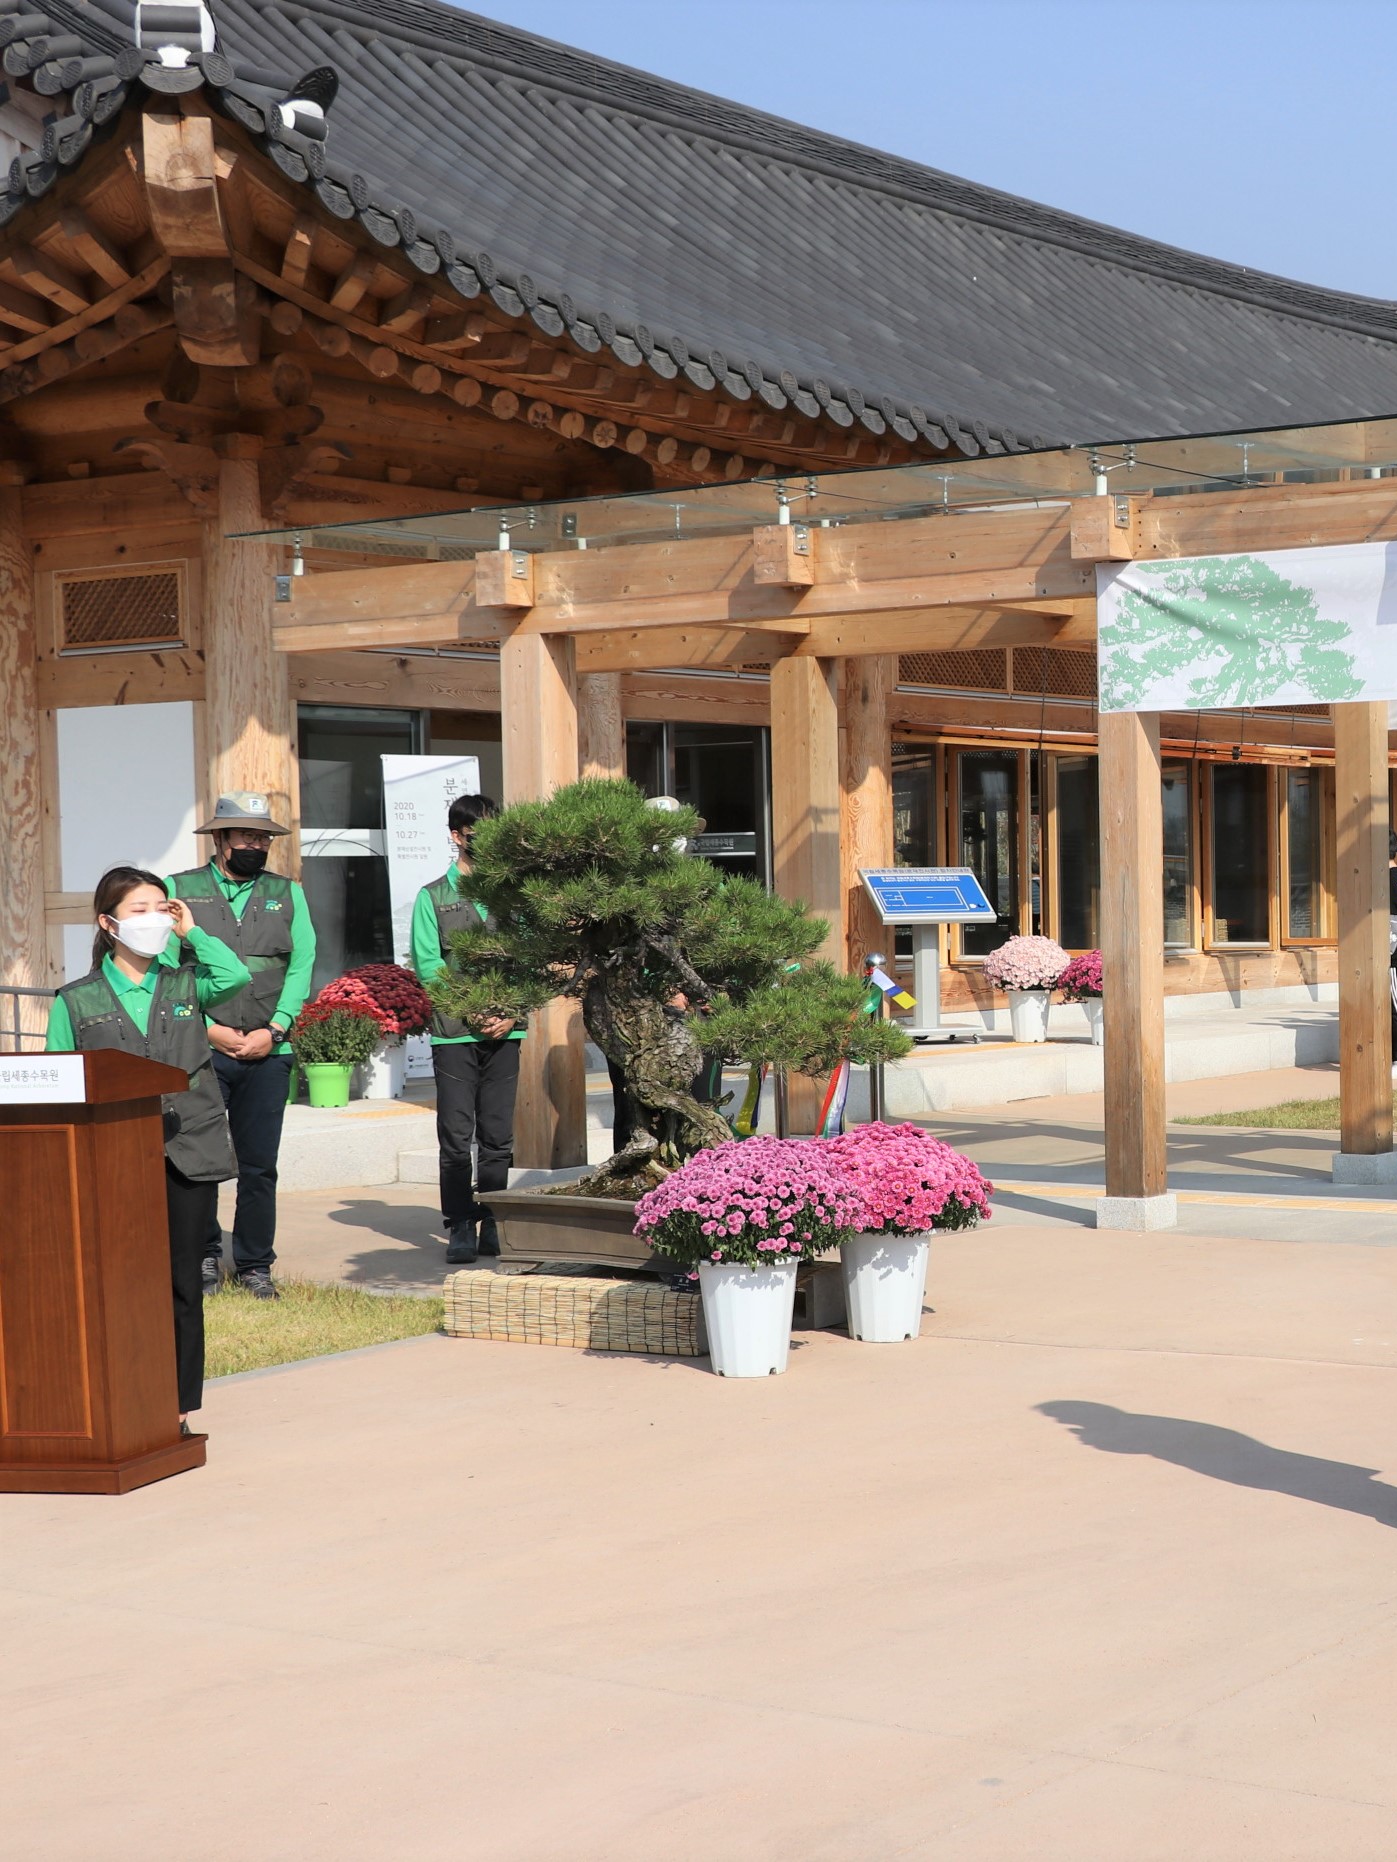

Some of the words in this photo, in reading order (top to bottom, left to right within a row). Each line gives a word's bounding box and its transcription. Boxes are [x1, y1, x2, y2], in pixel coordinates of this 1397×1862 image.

[394, 802, 414, 810] 2020
[395, 813, 417, 821] 10.18
[0, 1069, 59, 1082] 립세종수목원
